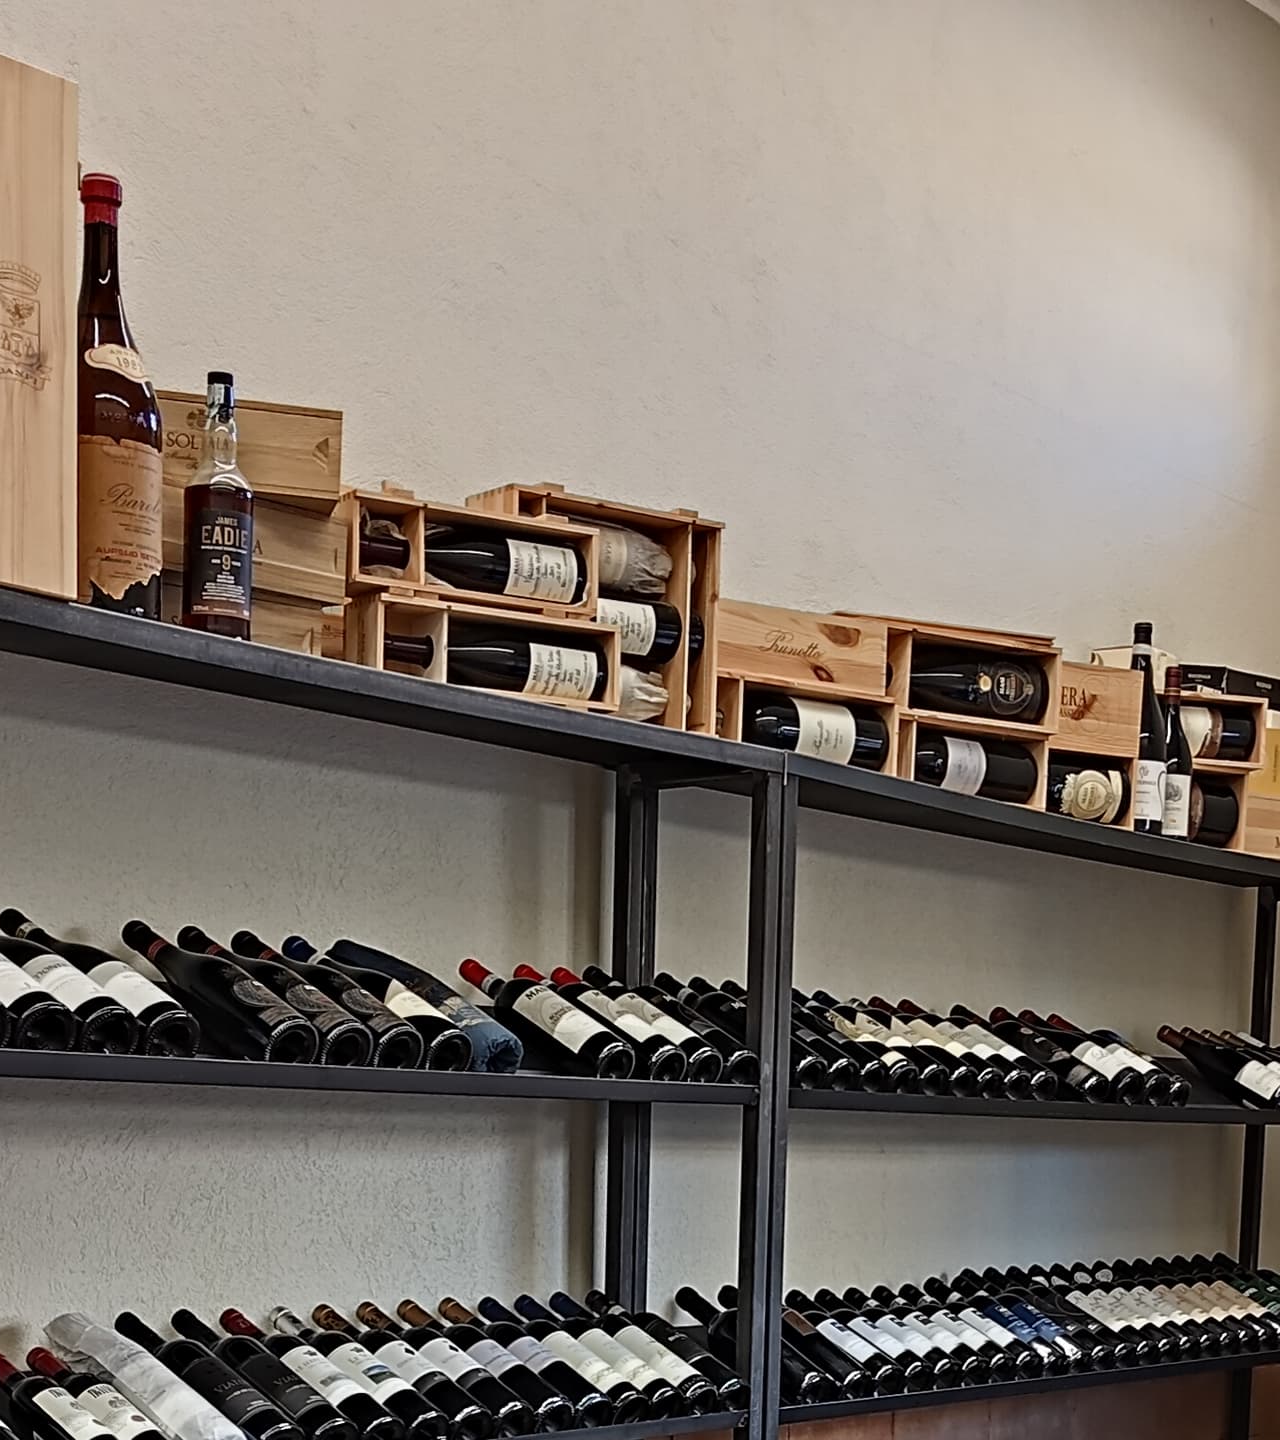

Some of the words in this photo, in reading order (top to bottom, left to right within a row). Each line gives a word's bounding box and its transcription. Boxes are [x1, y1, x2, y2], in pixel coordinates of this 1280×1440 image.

[215, 516, 239, 527] JAMES
[201, 525, 249, 550] EADIE
[222, 553, 232, 572] 9
